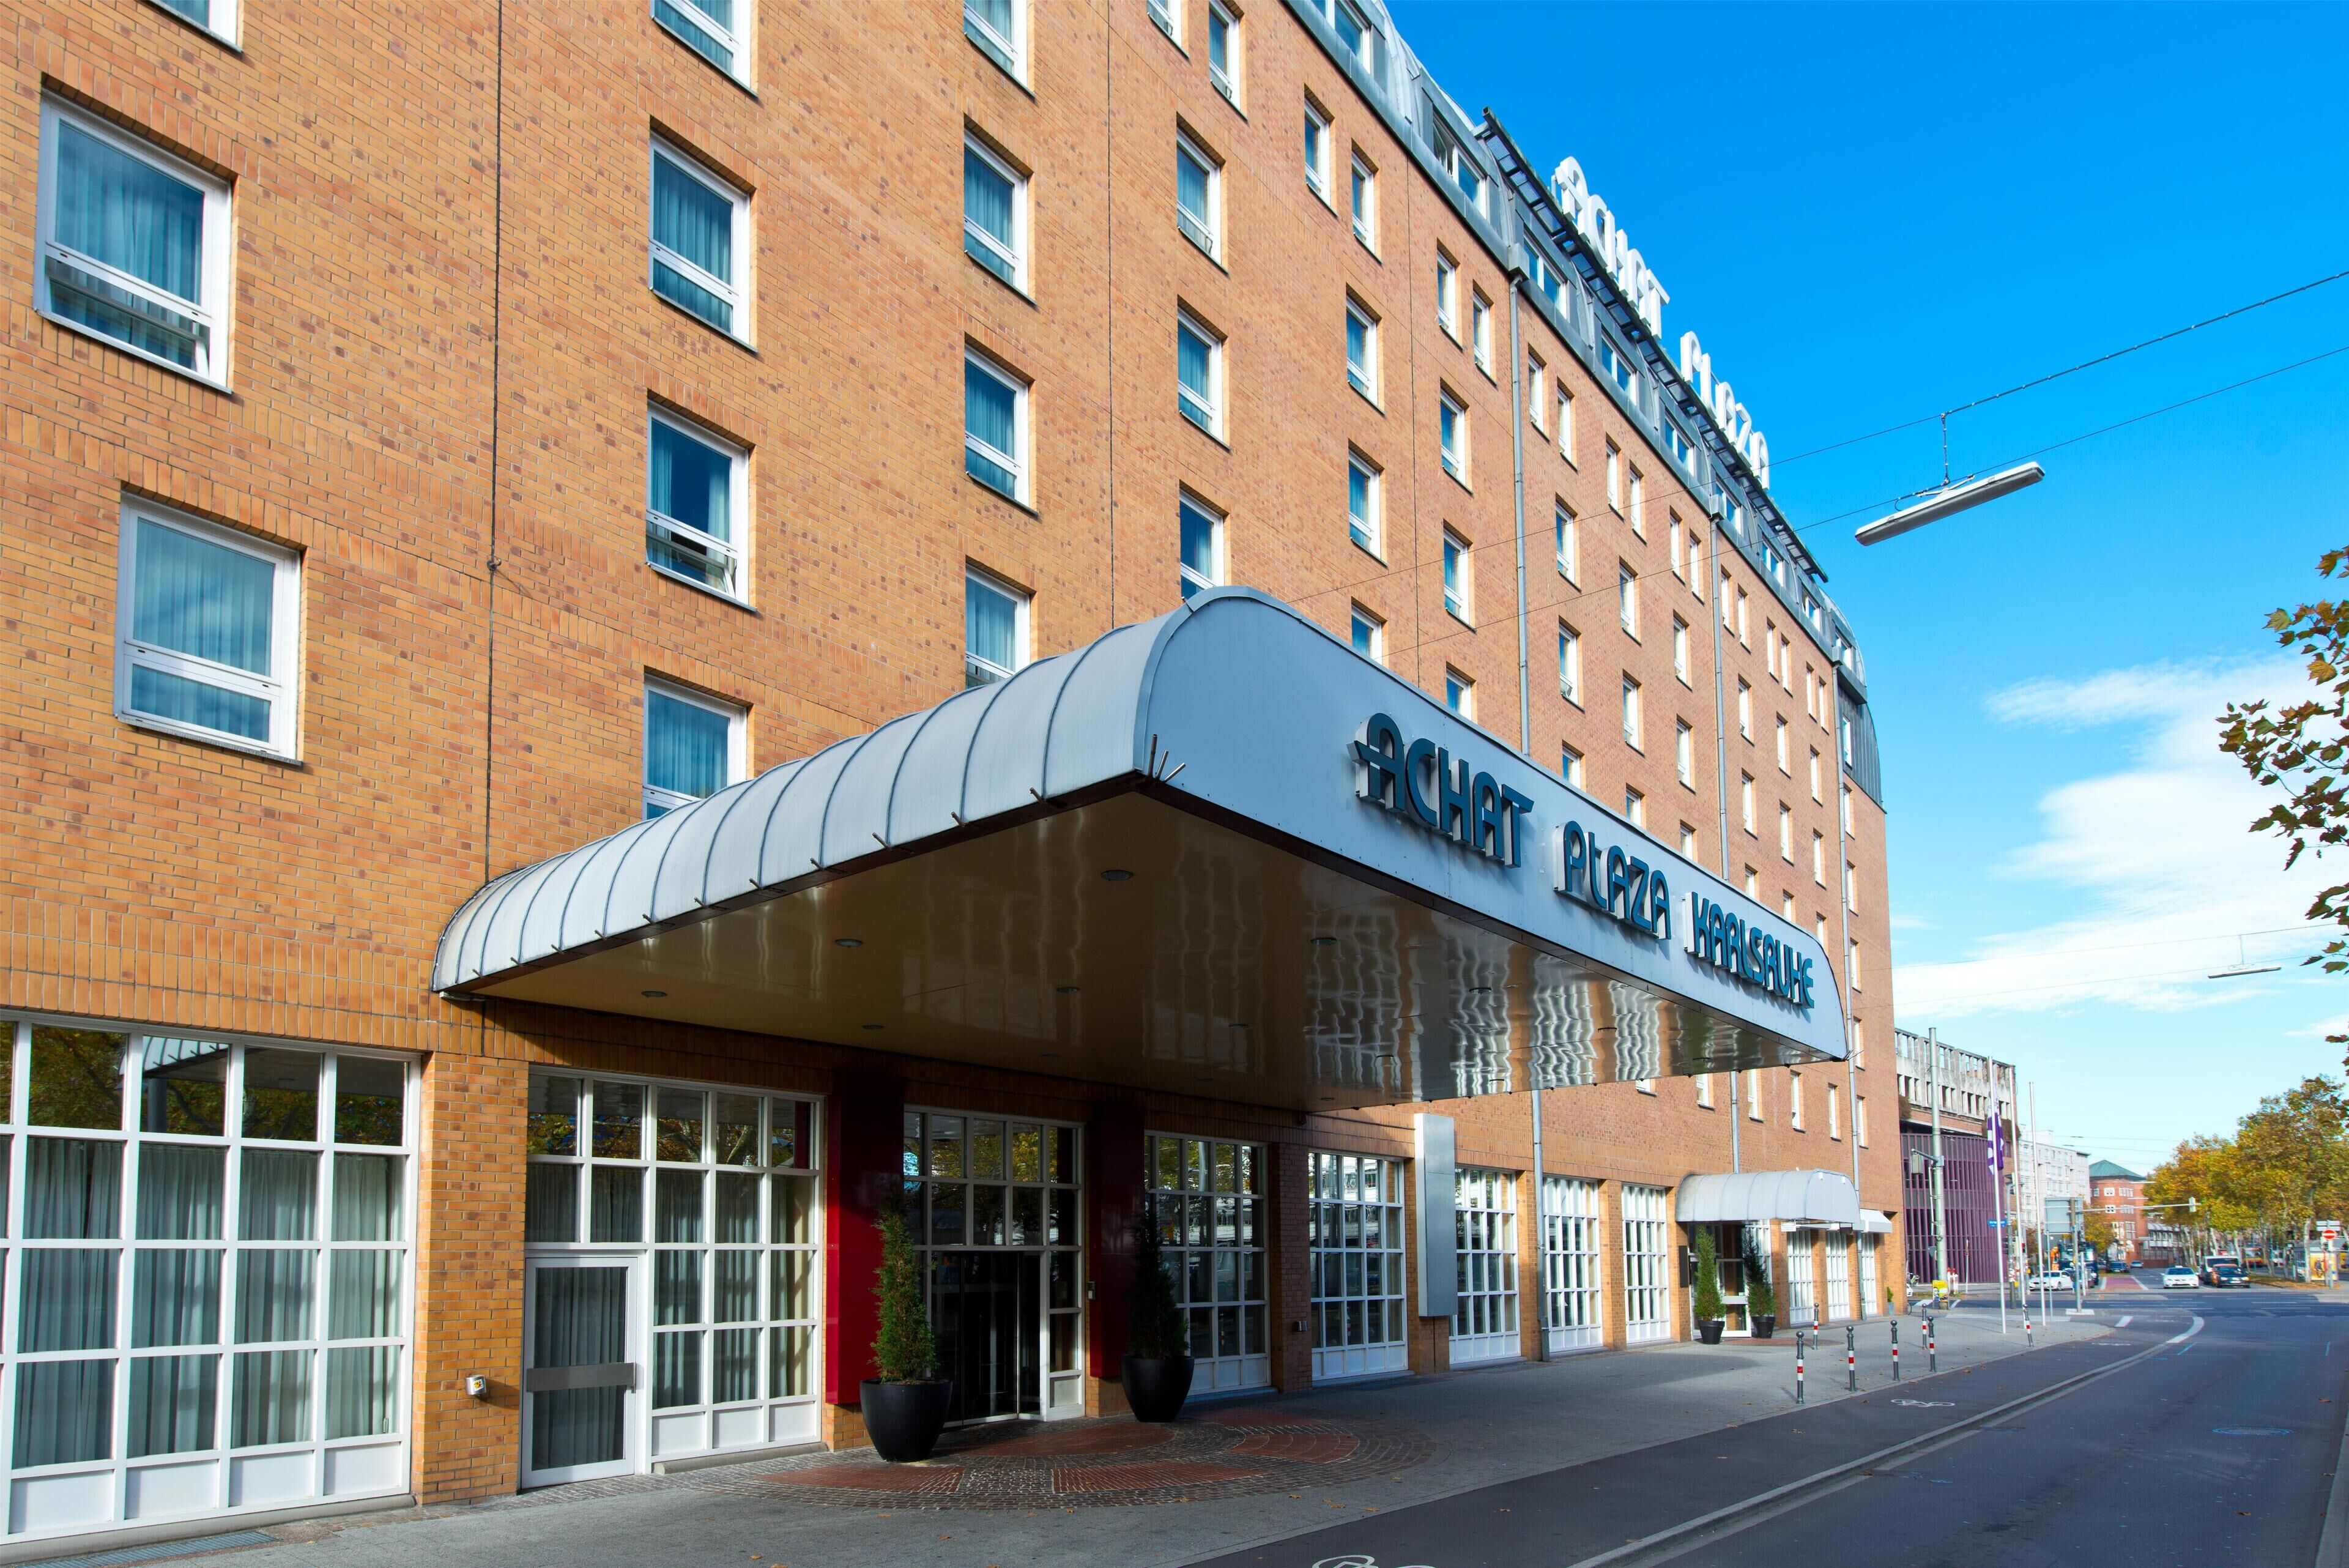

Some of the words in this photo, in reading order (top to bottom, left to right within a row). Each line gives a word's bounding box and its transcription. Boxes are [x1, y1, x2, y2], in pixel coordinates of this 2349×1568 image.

[1554, 156, 1670, 340] ACHAT
[1680, 331, 1770, 490] PLAZA
[1348, 713, 1534, 868] ACHAT
[1554, 820, 1672, 940] PLAZA
[1684, 891, 1814, 1009] KARLSRUHE
